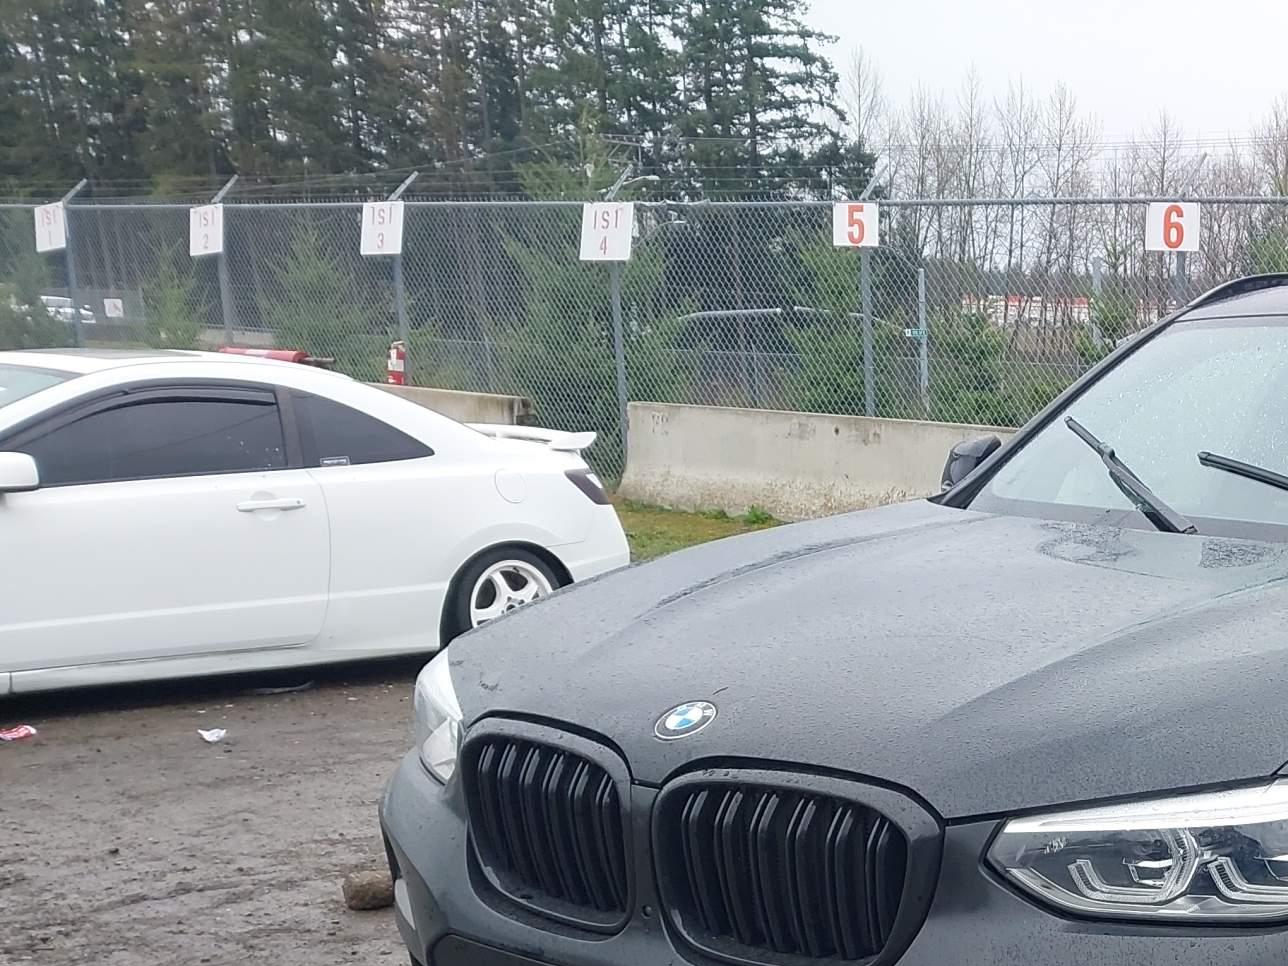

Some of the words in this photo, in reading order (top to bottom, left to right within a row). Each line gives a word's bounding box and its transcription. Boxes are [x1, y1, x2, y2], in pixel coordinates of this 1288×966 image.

[377, 231, 385, 249] 3
[848, 204, 864, 245] 5
[1163, 204, 1184, 249] 6
[599, 235, 608, 256] 4
